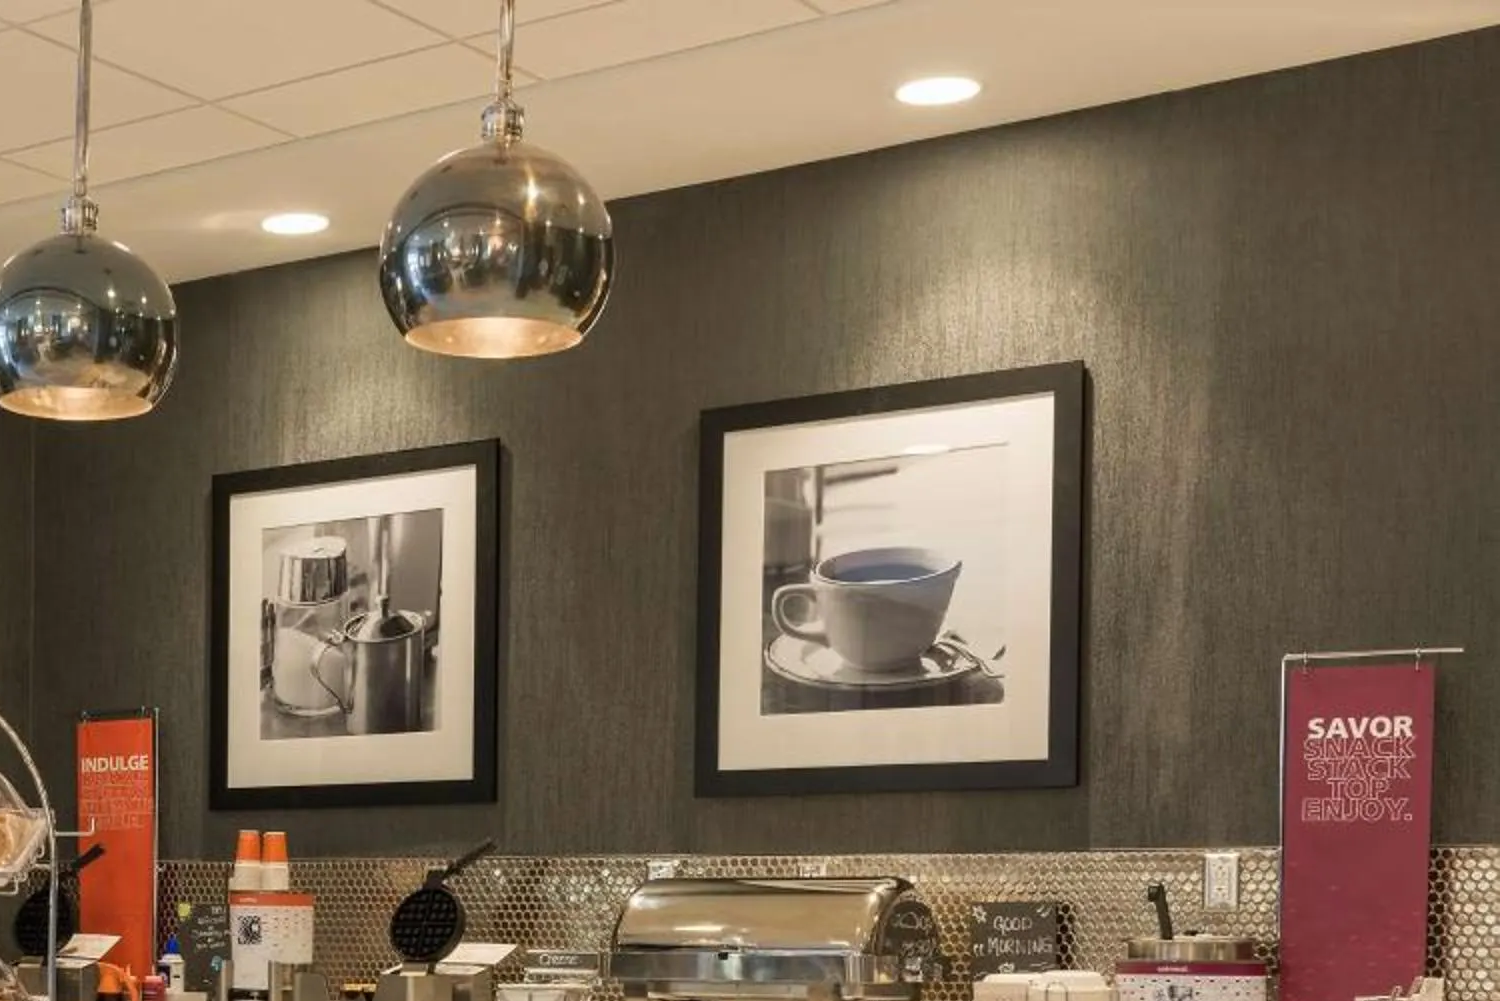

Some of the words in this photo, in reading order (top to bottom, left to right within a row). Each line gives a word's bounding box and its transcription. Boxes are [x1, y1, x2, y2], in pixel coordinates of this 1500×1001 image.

[1307, 715, 1414, 739] SAVOR
[1303, 736, 1417, 760] SNACK
[81, 755, 149, 774] INDULGE
[1307, 757, 1411, 780] STACK
[1327, 777, 1391, 801] TOP
[1301, 797, 1414, 822] ENJOY.
[993, 915, 1033, 936] GOOD
[987, 936, 1053, 957] MORNING
